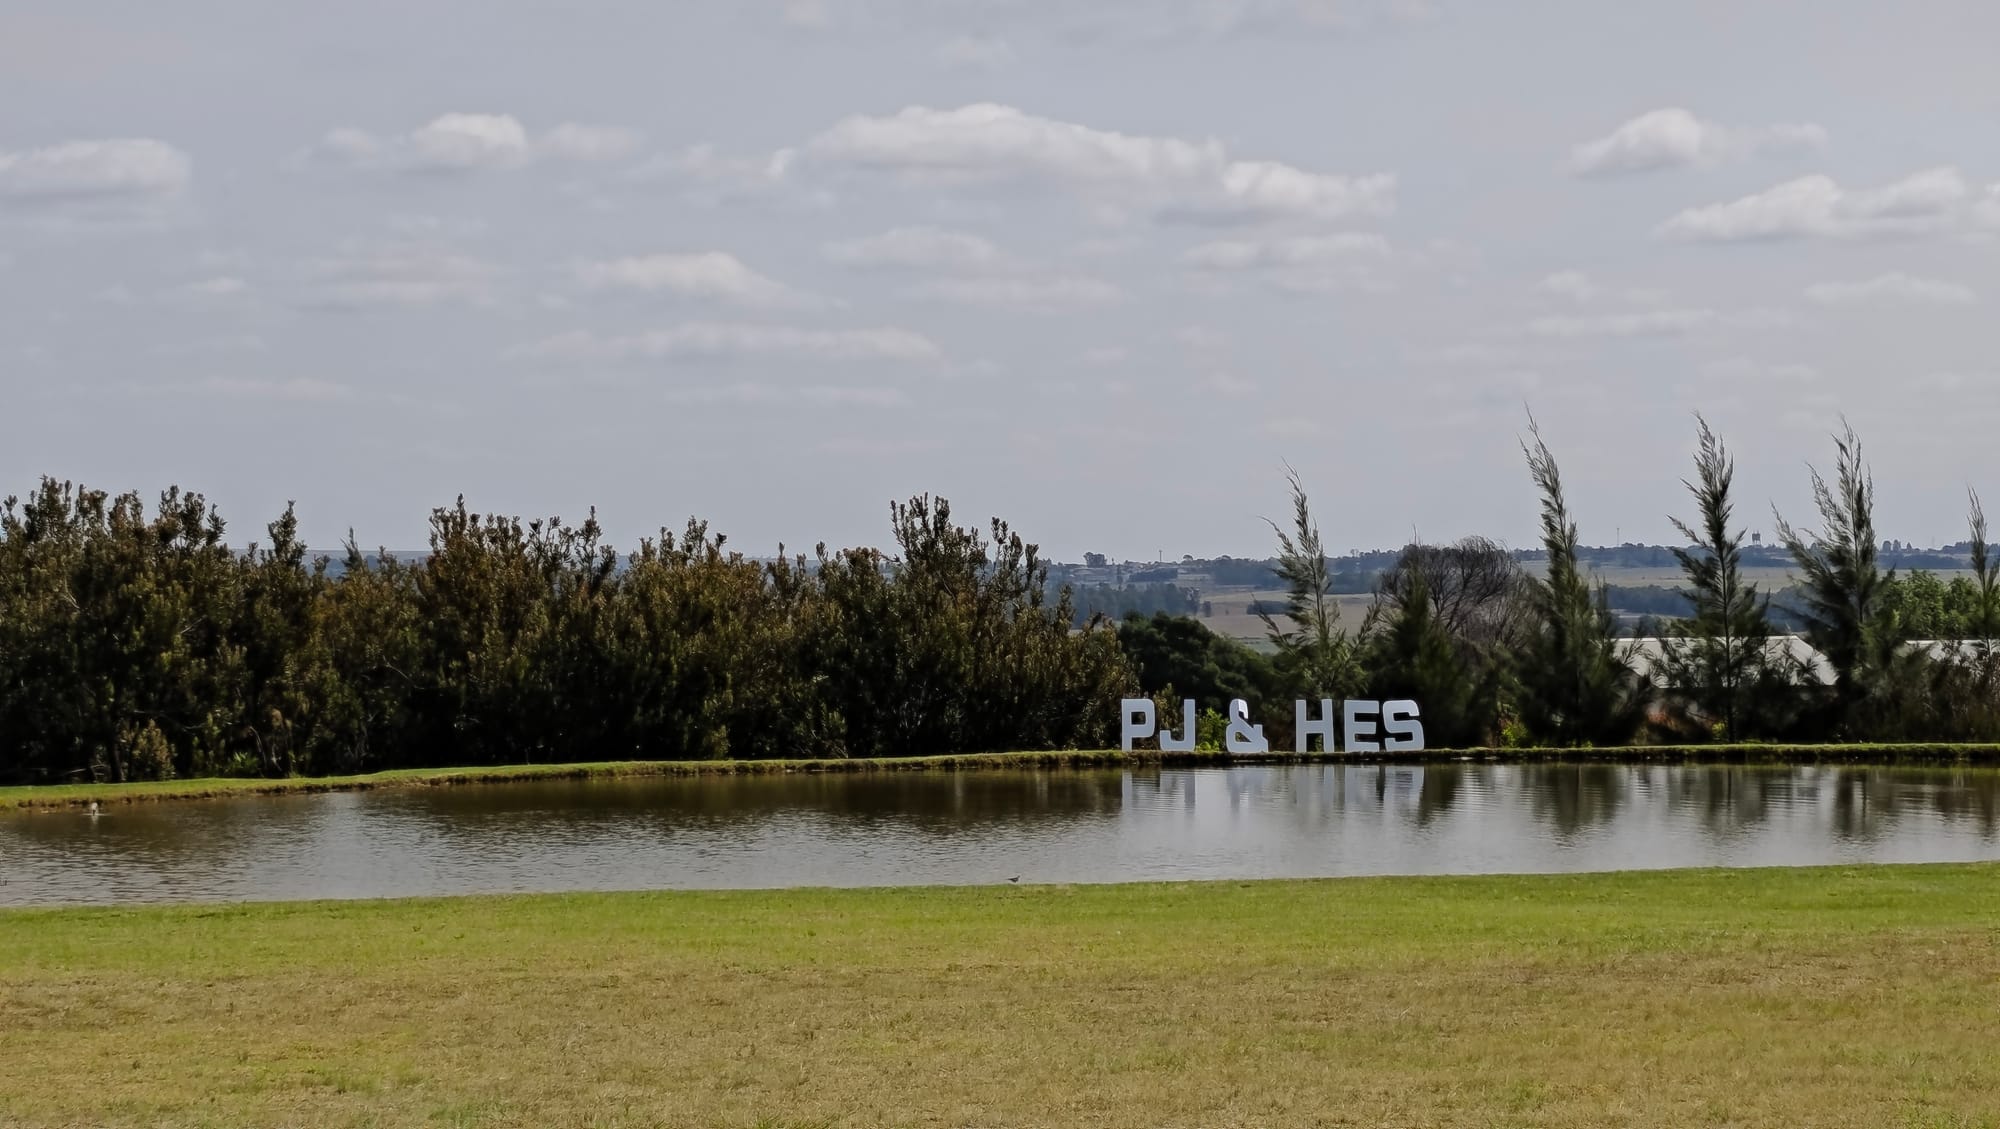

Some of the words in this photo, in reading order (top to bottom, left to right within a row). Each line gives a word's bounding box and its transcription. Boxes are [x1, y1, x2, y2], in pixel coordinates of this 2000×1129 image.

[1121, 699, 1195, 751] PJ
[1225, 699, 1269, 753] &
[1296, 699, 1425, 753] HES
